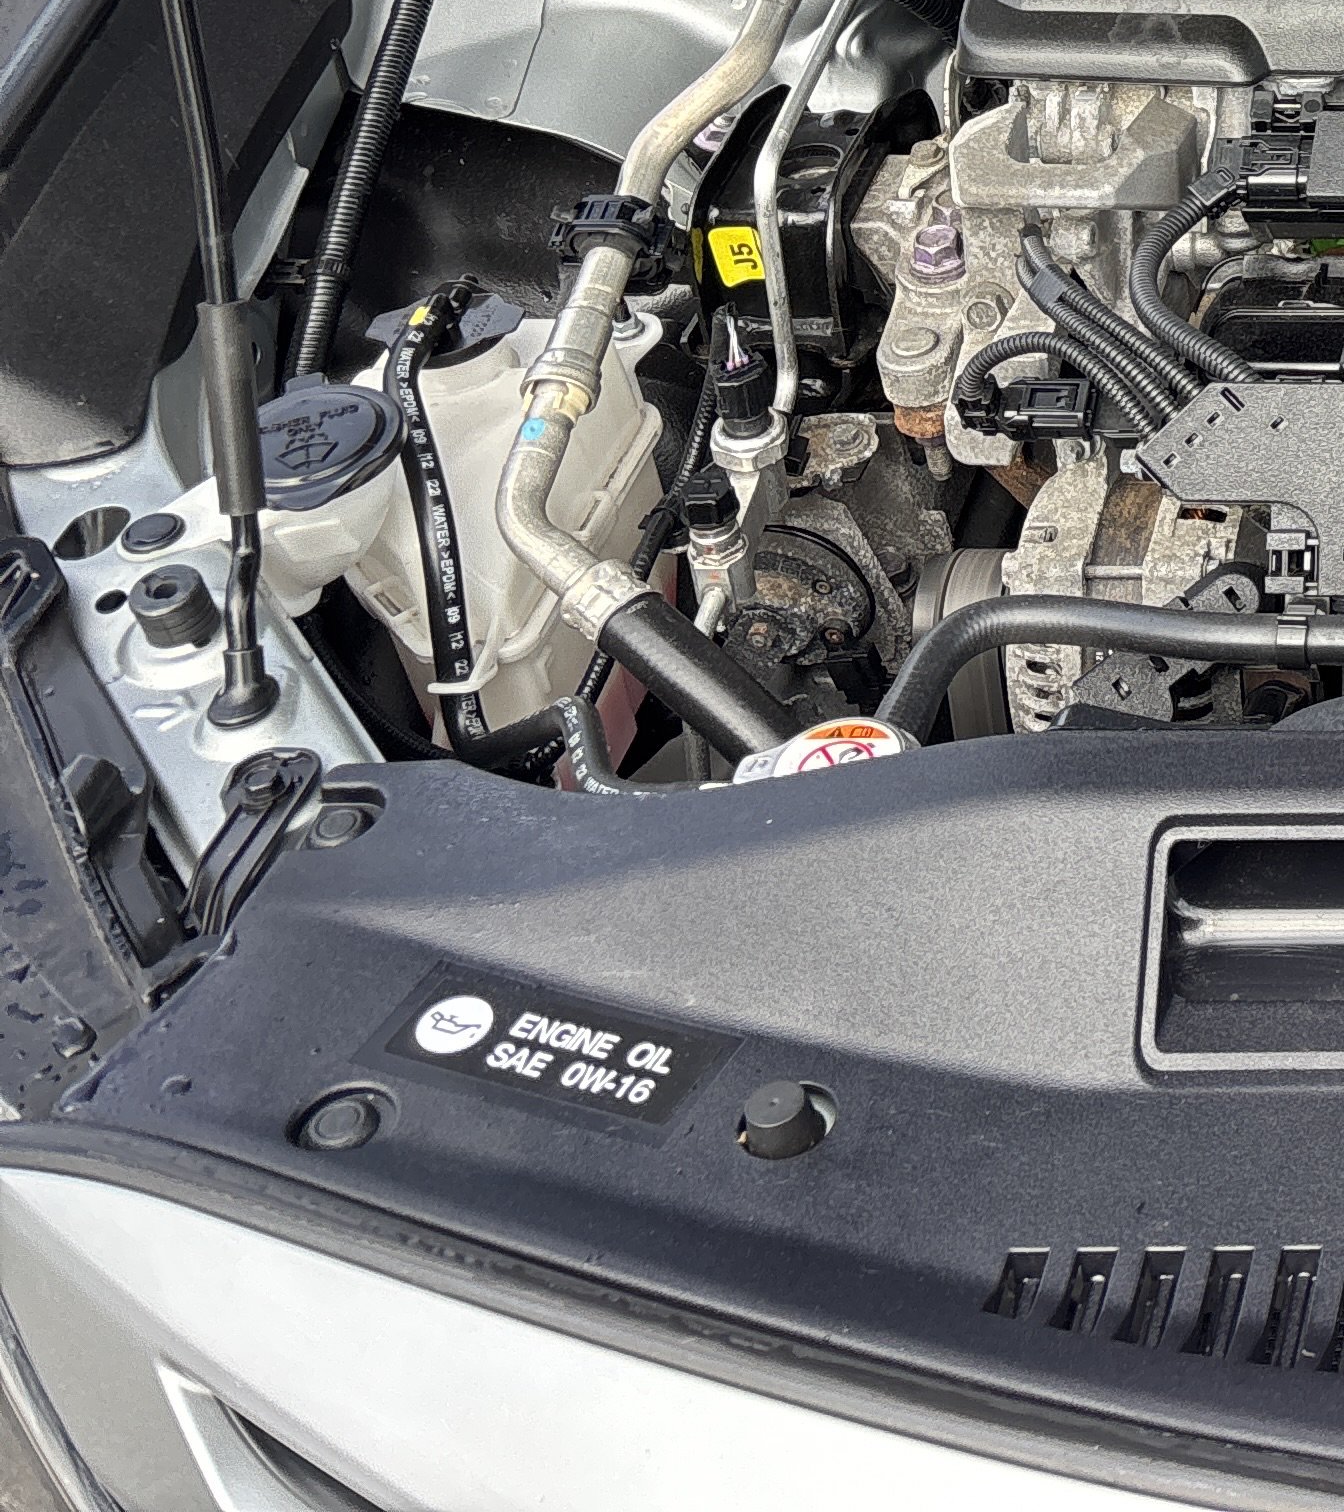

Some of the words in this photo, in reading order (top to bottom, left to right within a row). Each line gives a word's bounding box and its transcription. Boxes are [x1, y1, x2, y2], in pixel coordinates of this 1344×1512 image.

[729, 242, 759, 271] J5
[405, 330, 425, 345] 22
[396, 347, 416, 384] WATER
[425, 479, 442, 498] 22
[431, 503, 451, 549] WATER
[439, 550, 457, 601] >EPDM<
[453, 659, 471, 677] 22
[509, 1011, 621, 1059] ENGINE
[626, 1041, 673, 1075] OIL
[486, 1042, 553, 1078] SAE
[560, 1061, 655, 1104] 0W-16
